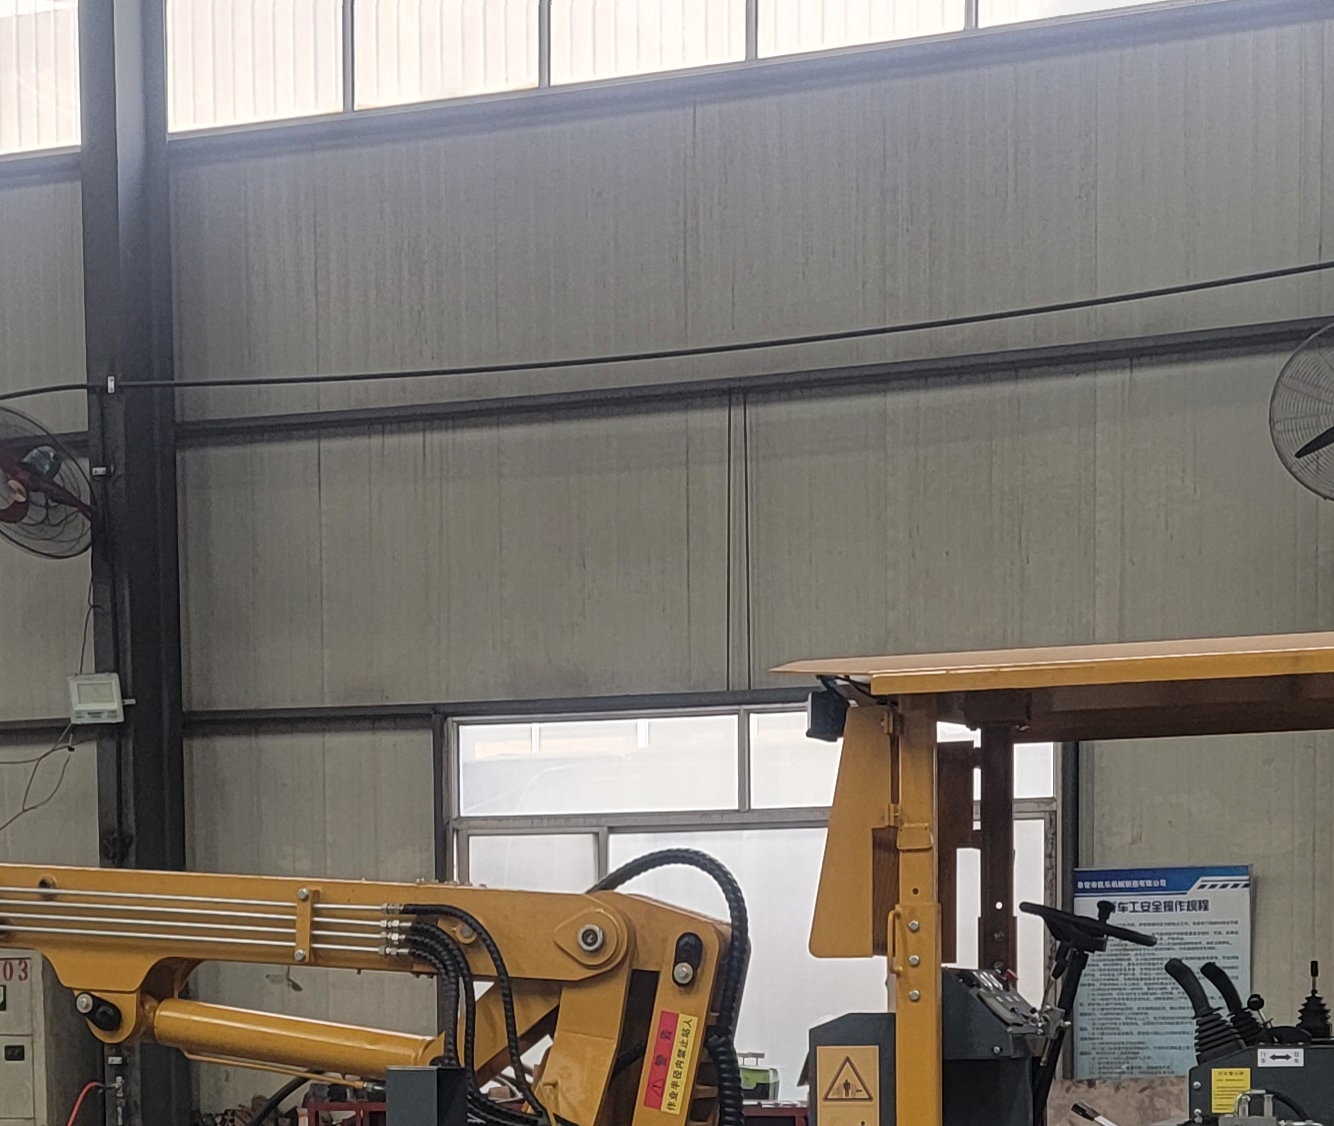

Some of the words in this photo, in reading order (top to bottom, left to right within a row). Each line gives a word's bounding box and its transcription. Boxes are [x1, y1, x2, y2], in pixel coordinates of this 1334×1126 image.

[1111, 899, 1210, 914] 车工安全操作规程
